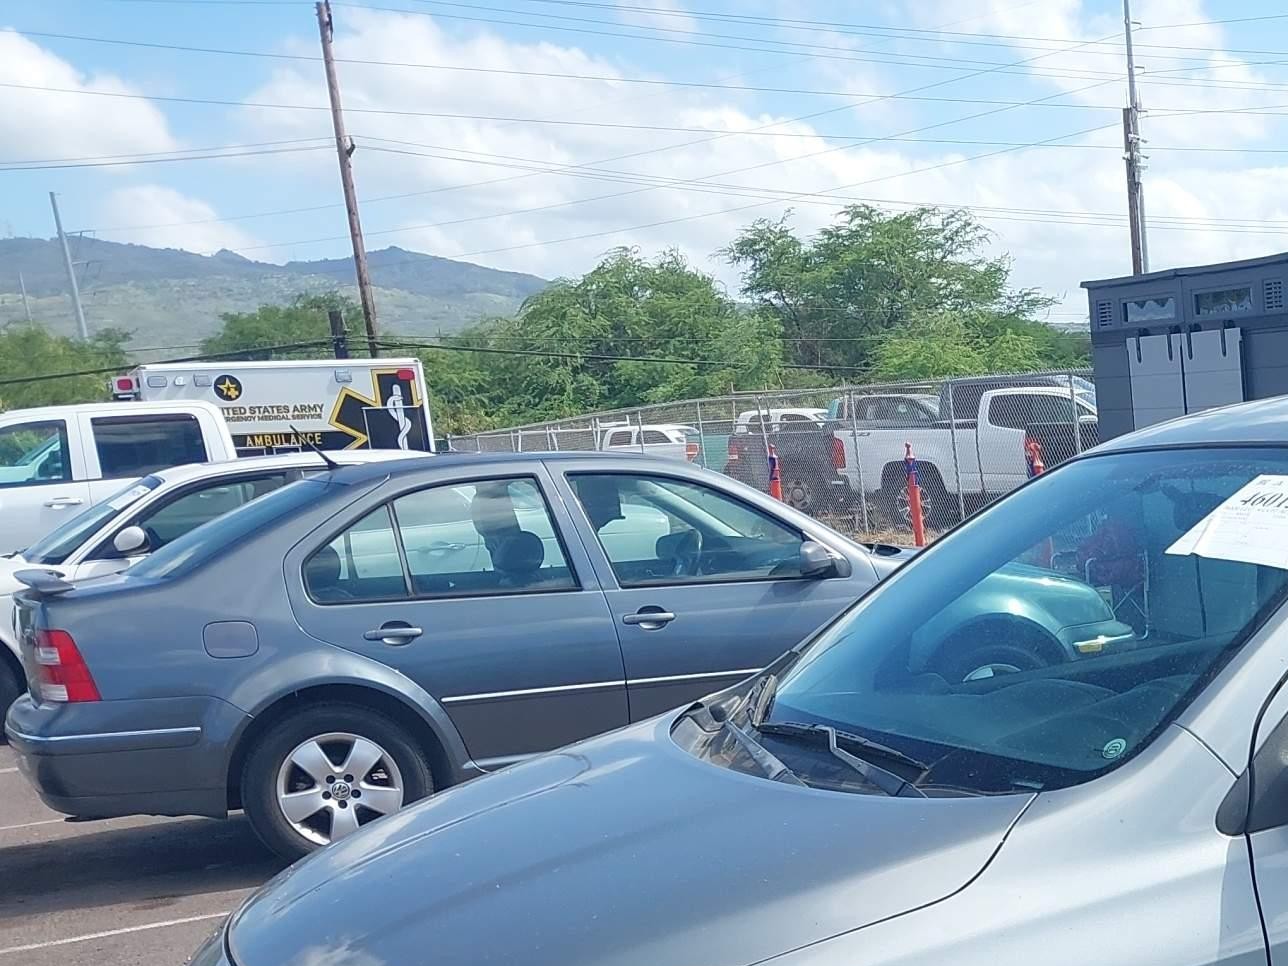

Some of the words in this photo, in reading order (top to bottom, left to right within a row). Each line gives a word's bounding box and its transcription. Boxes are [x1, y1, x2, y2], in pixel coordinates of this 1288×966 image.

[221, 407, 247, 416] ITED
[249, 405, 290, 415] STATES
[292, 403, 324, 414] ARMY
[246, 432, 323, 447] AMBULANCE
